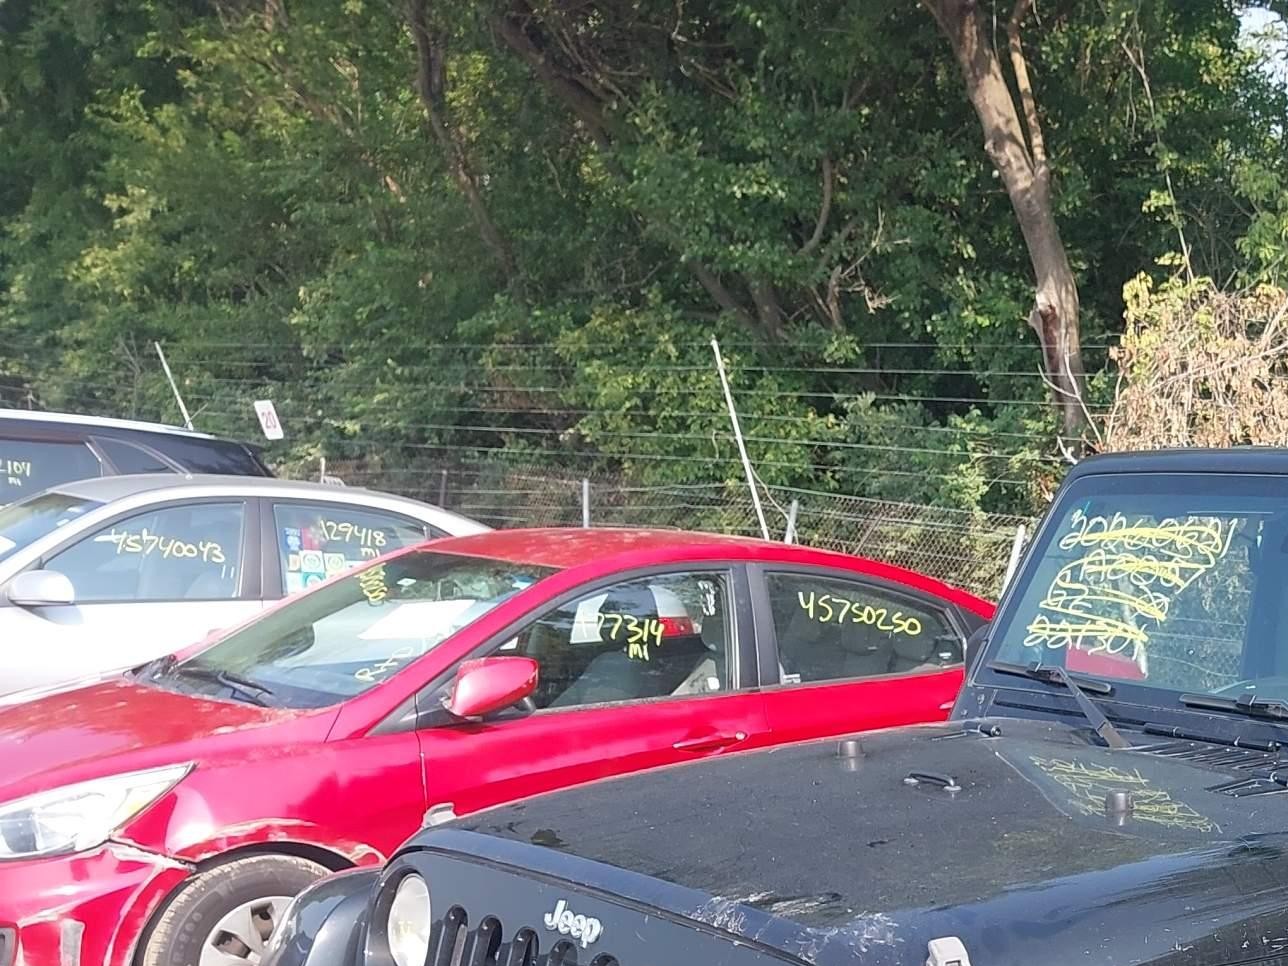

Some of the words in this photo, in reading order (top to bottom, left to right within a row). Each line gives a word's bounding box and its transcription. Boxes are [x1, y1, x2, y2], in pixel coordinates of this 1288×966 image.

[0, 459, 32, 477] 104
[108, 528, 226, 563] 45740043
[319, 519, 387, 547] 129418
[798, 591, 922, 636] 45750250
[543, 898, 604, 949] Jeep
